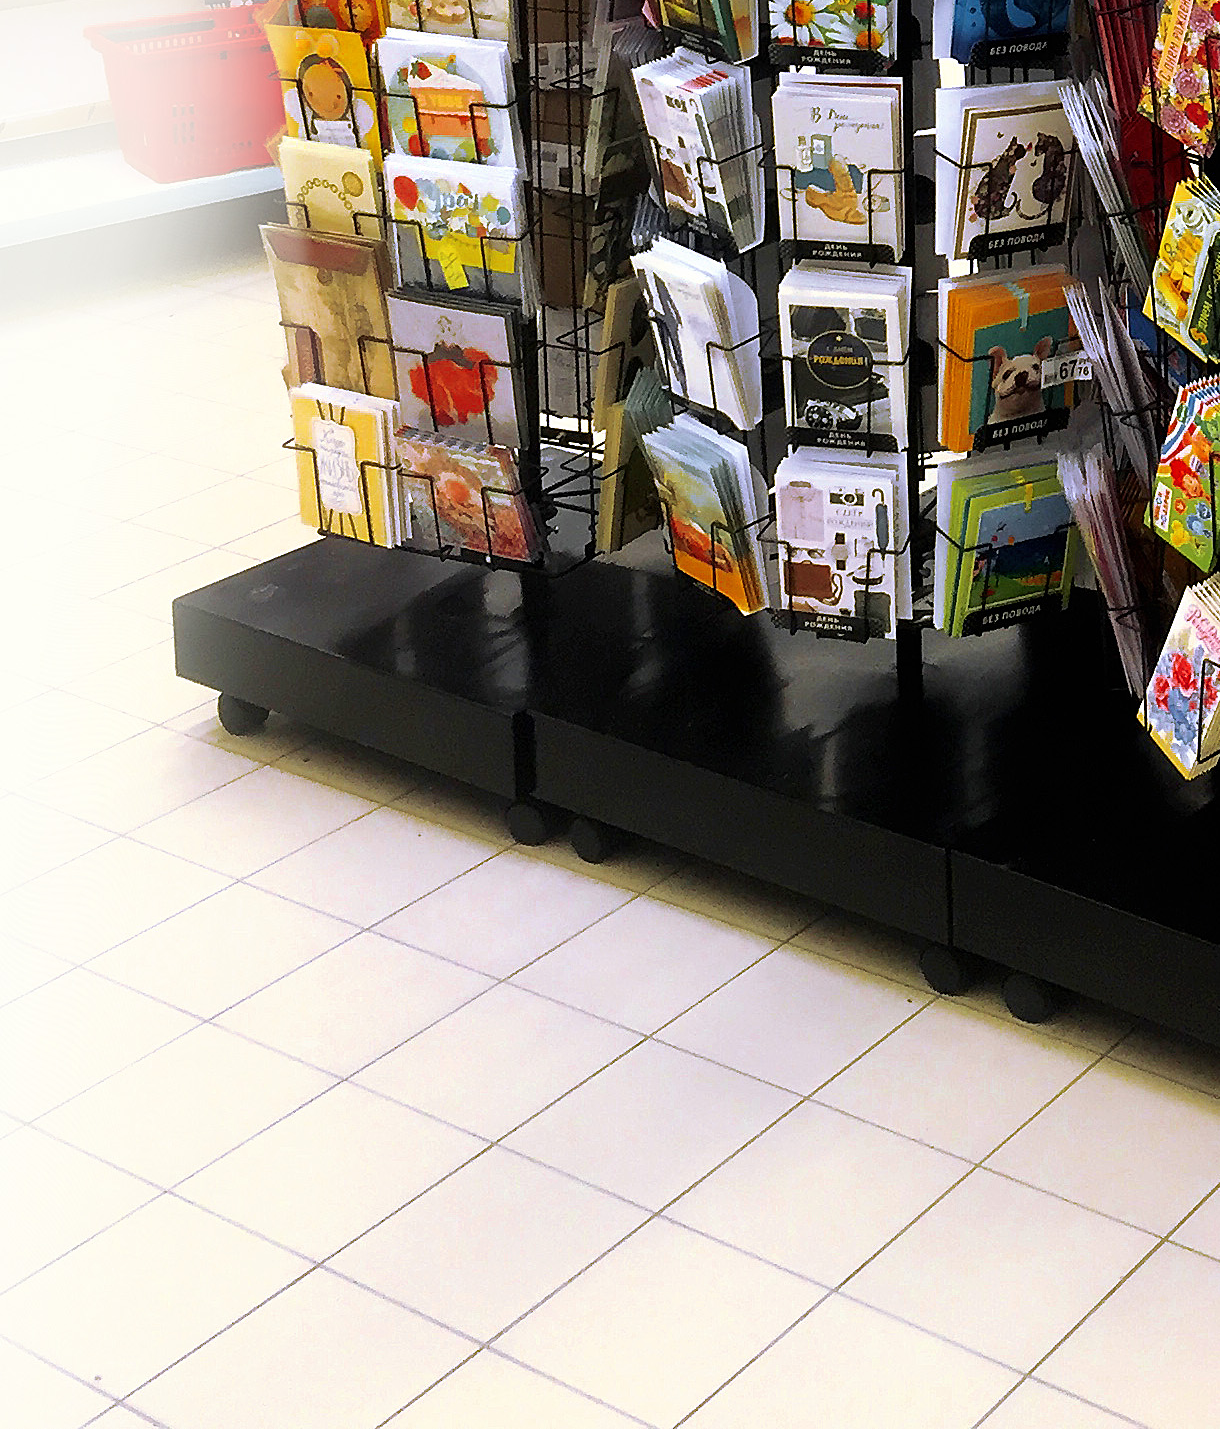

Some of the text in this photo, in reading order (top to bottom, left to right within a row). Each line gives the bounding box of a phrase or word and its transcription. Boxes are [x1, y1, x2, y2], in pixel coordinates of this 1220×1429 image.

[813, 49, 837, 57] ДЕНЬ
[989, 41, 1047, 55] БЕЗ ПОВОДА
[801, 55, 851, 64] РОЖДЕНИЯ
[988, 232, 1045, 249] БЕЗ ПОВОДА
[824, 243, 848, 251] ДЕНЬ
[812, 250, 862, 258] РОЖДЕНИЯ
[1060, 359, 1077, 379] 67
[816, 437, 866, 447] РОЖДЕНИЯ
[1002, 604, 1042, 622] ПОВОДА
[816, 615, 840, 623] ДЕНЬ
[804, 621, 853, 631] РОЖДЕНИЯ
